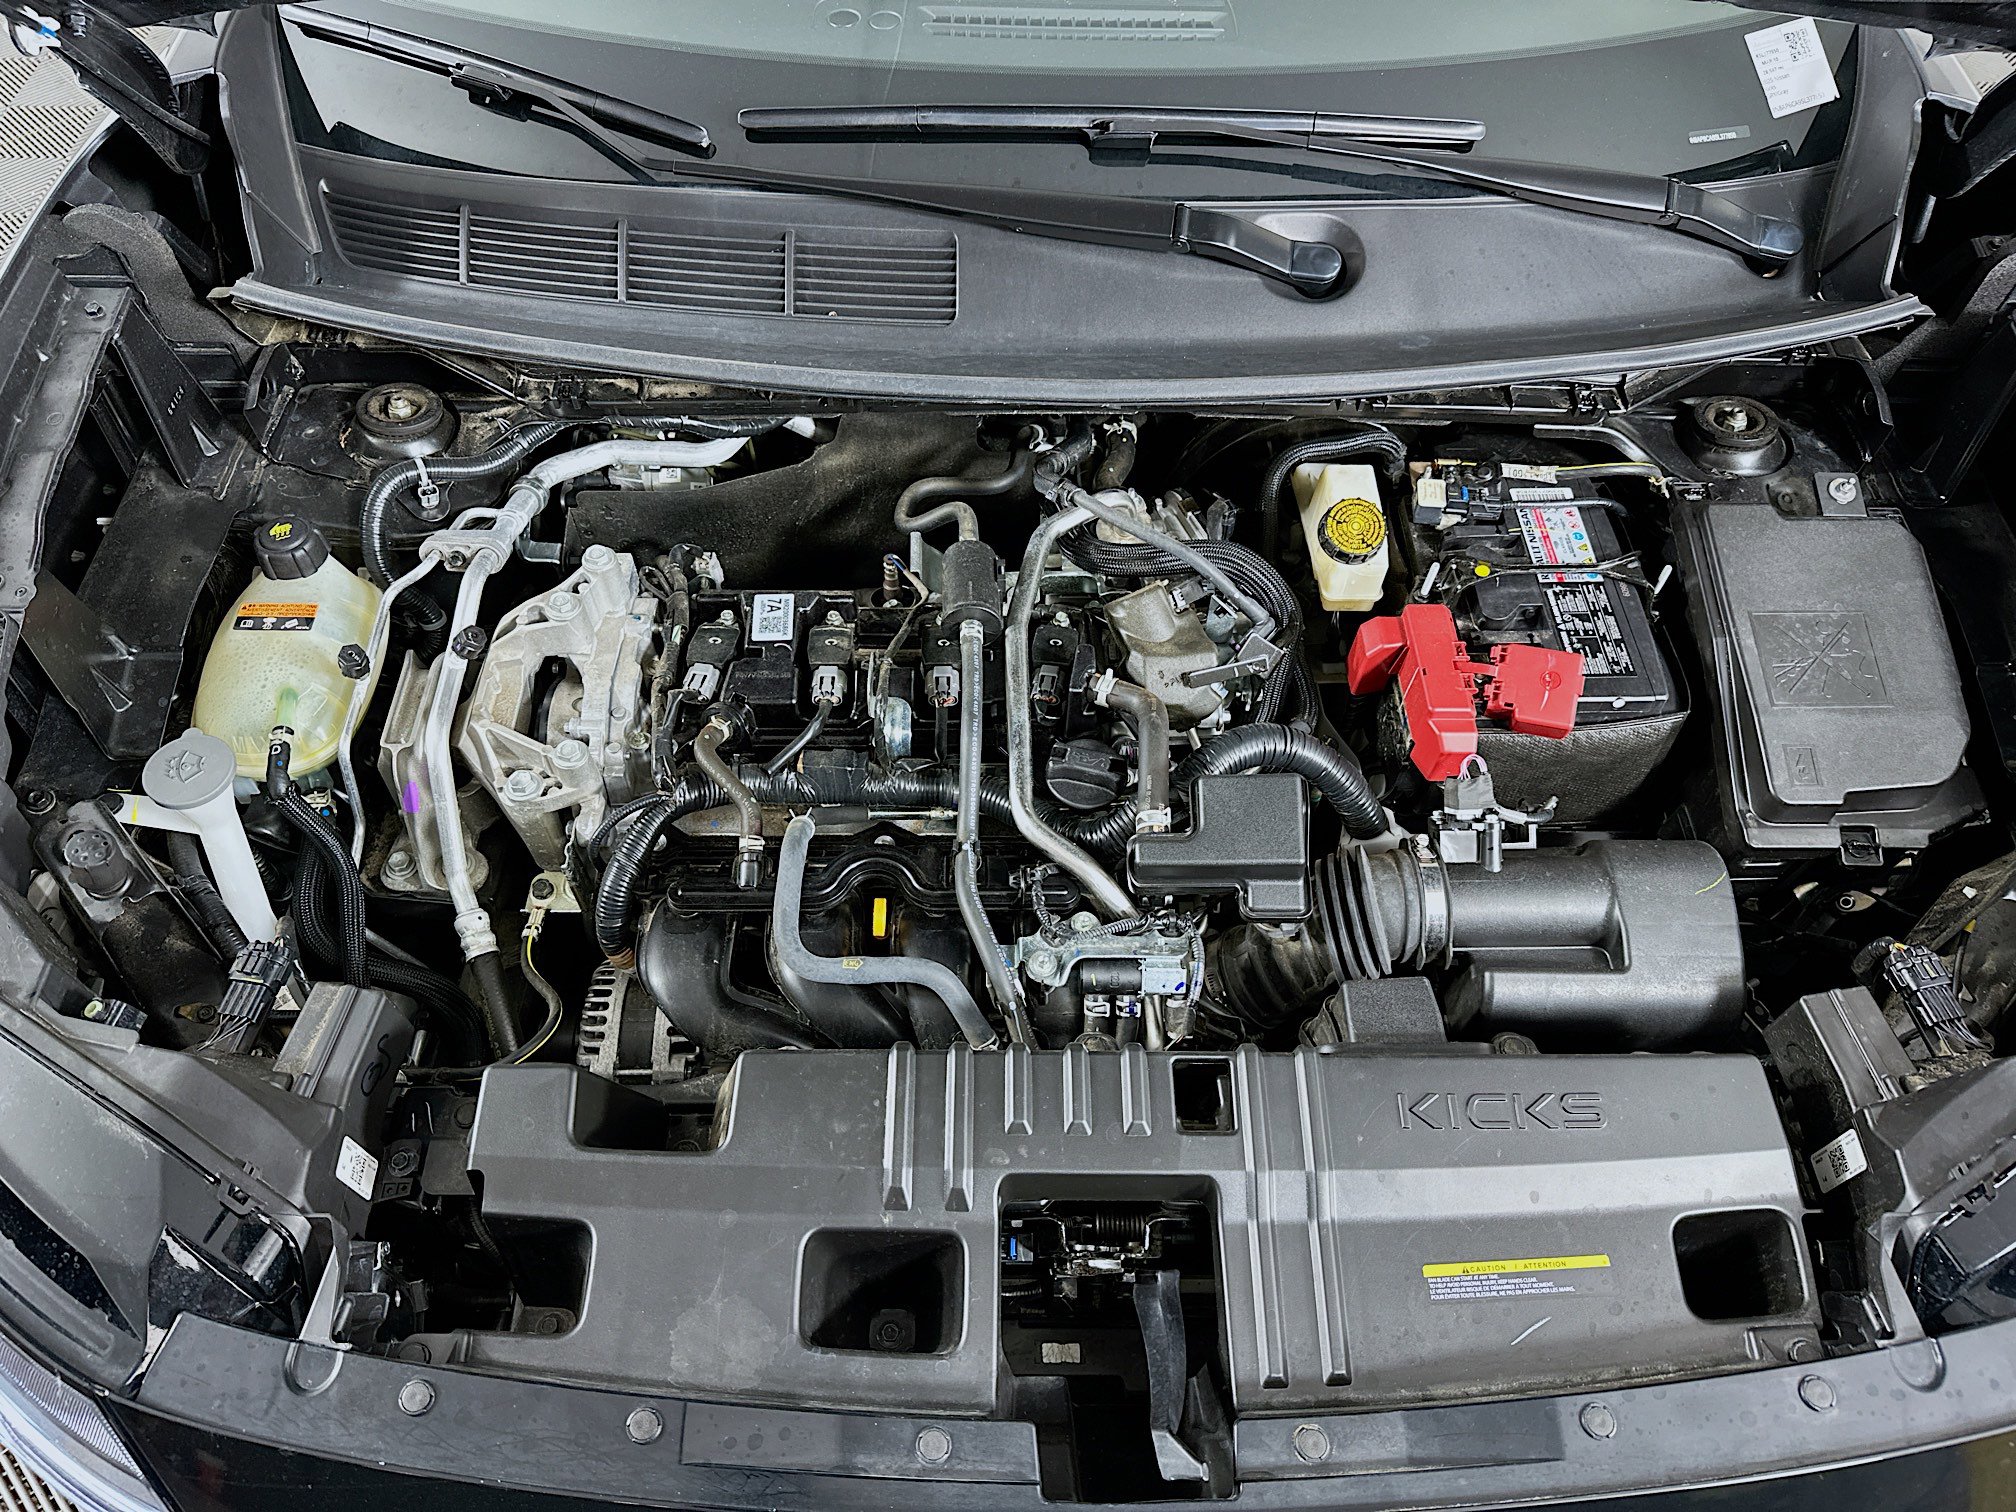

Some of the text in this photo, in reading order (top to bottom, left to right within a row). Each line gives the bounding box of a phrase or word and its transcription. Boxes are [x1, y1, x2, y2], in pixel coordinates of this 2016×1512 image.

[767, 598, 781, 613] 7A
[1397, 1092, 1608, 1130] KICKS
[1470, 1264, 1506, 1272] CAUTION
[1523, 1260, 1567, 1270] ATTENTION
